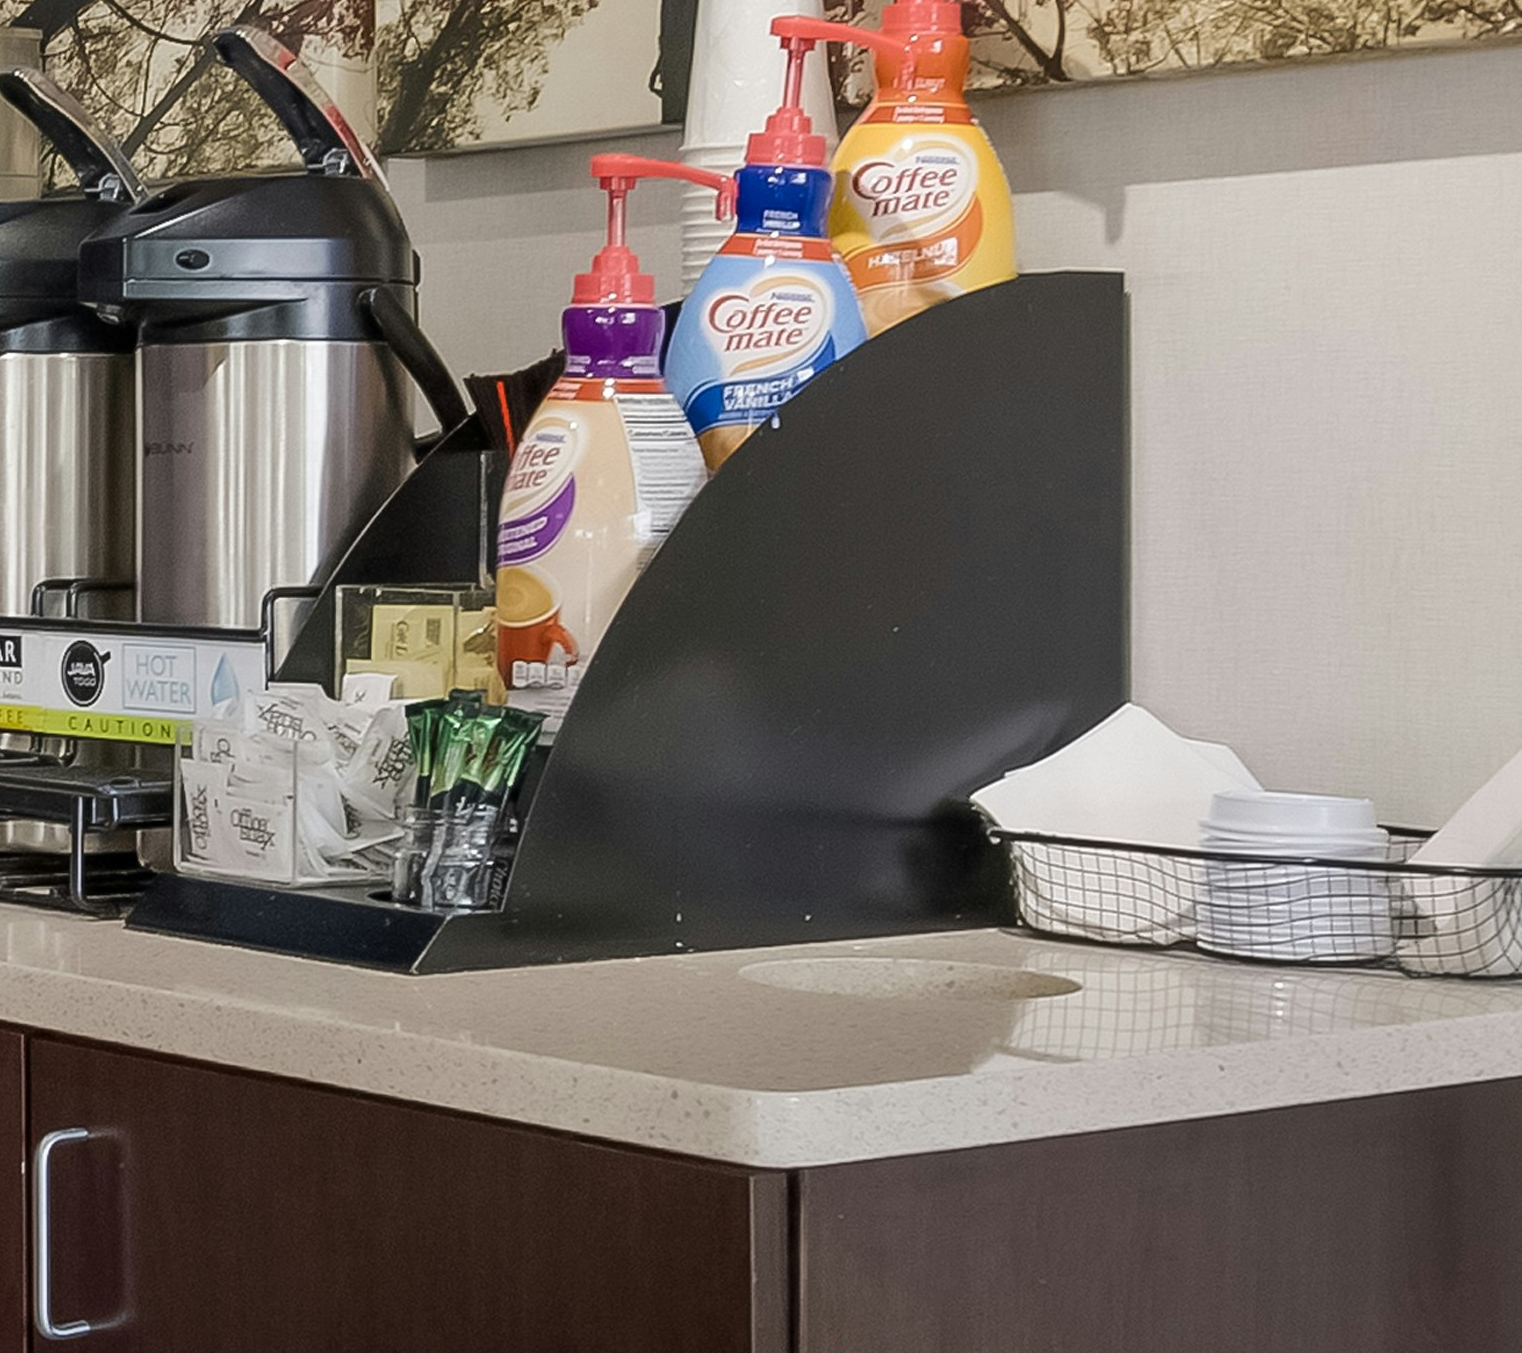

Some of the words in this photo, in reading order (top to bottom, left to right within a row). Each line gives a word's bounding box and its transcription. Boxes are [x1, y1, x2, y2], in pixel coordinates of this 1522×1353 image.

[852, 161, 958, 200] Coffee
[872, 190, 950, 217] mate
[709, 295, 812, 334] Coffee
[725, 327, 803, 352] mate
[135, 654, 178, 678] HOT
[126, 679, 192, 705] WATER
[68, 716, 171, 739] CAUTION
